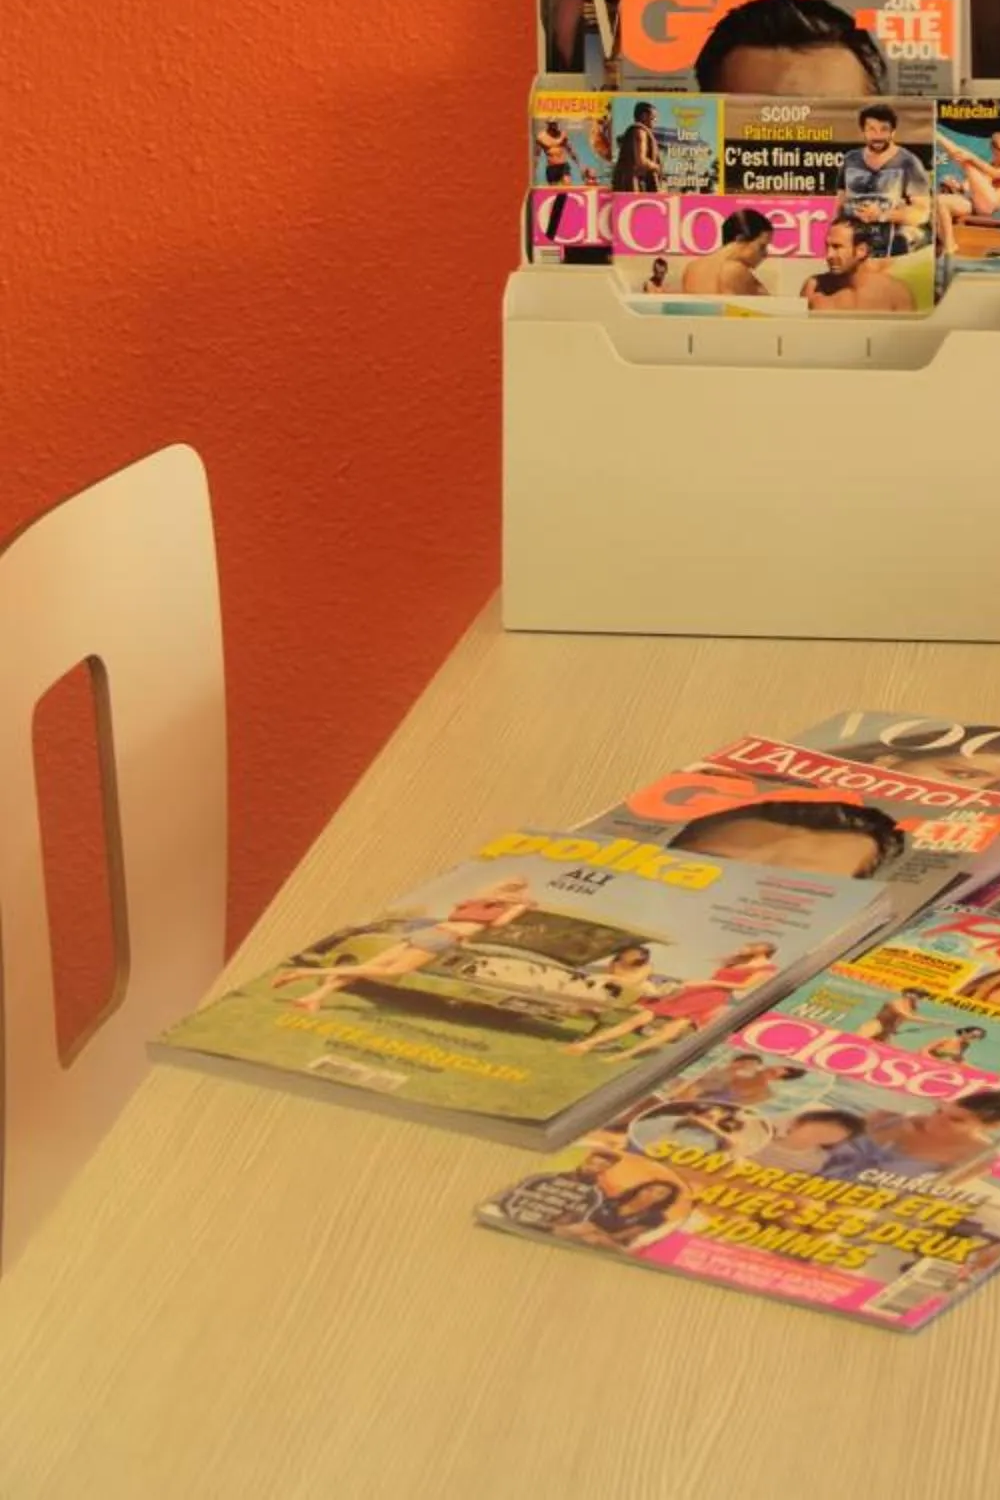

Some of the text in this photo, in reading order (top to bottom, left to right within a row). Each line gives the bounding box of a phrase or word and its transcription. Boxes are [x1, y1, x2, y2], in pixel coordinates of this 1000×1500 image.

[886, 40, 949, 61] COOL
[761, 106, 810, 121] SCOOP
[744, 126, 832, 140] Patrick Bruel
[726, 148, 844, 167] C'est fini avec
[743, 172, 815, 190] Caroline
[618, 196, 828, 258] Cloer
[479, 833, 723, 890] polka
[645, 1141, 733, 1179] SON
[732, 1158, 899, 1209] PREMIER
[699, 1183, 983, 1264] AVEC SES DEUX
[700, 1214, 878, 1269] HOMMES
